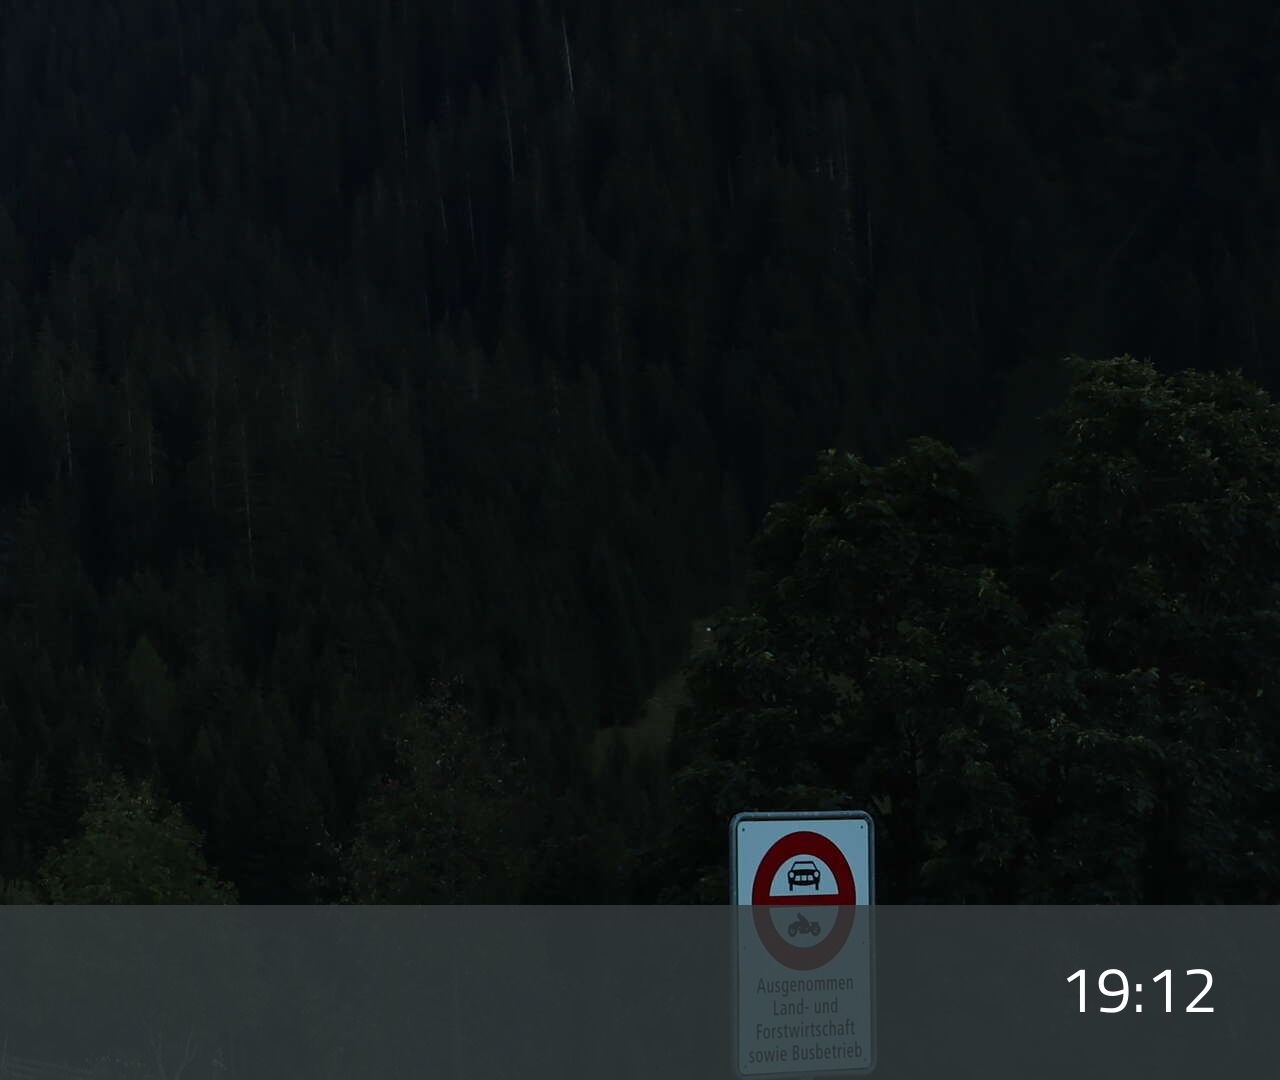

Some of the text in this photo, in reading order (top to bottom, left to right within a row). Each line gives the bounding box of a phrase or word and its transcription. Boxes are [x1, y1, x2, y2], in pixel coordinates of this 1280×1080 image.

[757, 977, 854, 997] Ausgenommen
[773, 995, 838, 1016] Land- und
[756, 1018, 855, 1040] Forstwirtschaft
[748, 1041, 862, 1064] sowie Busbetrieb
